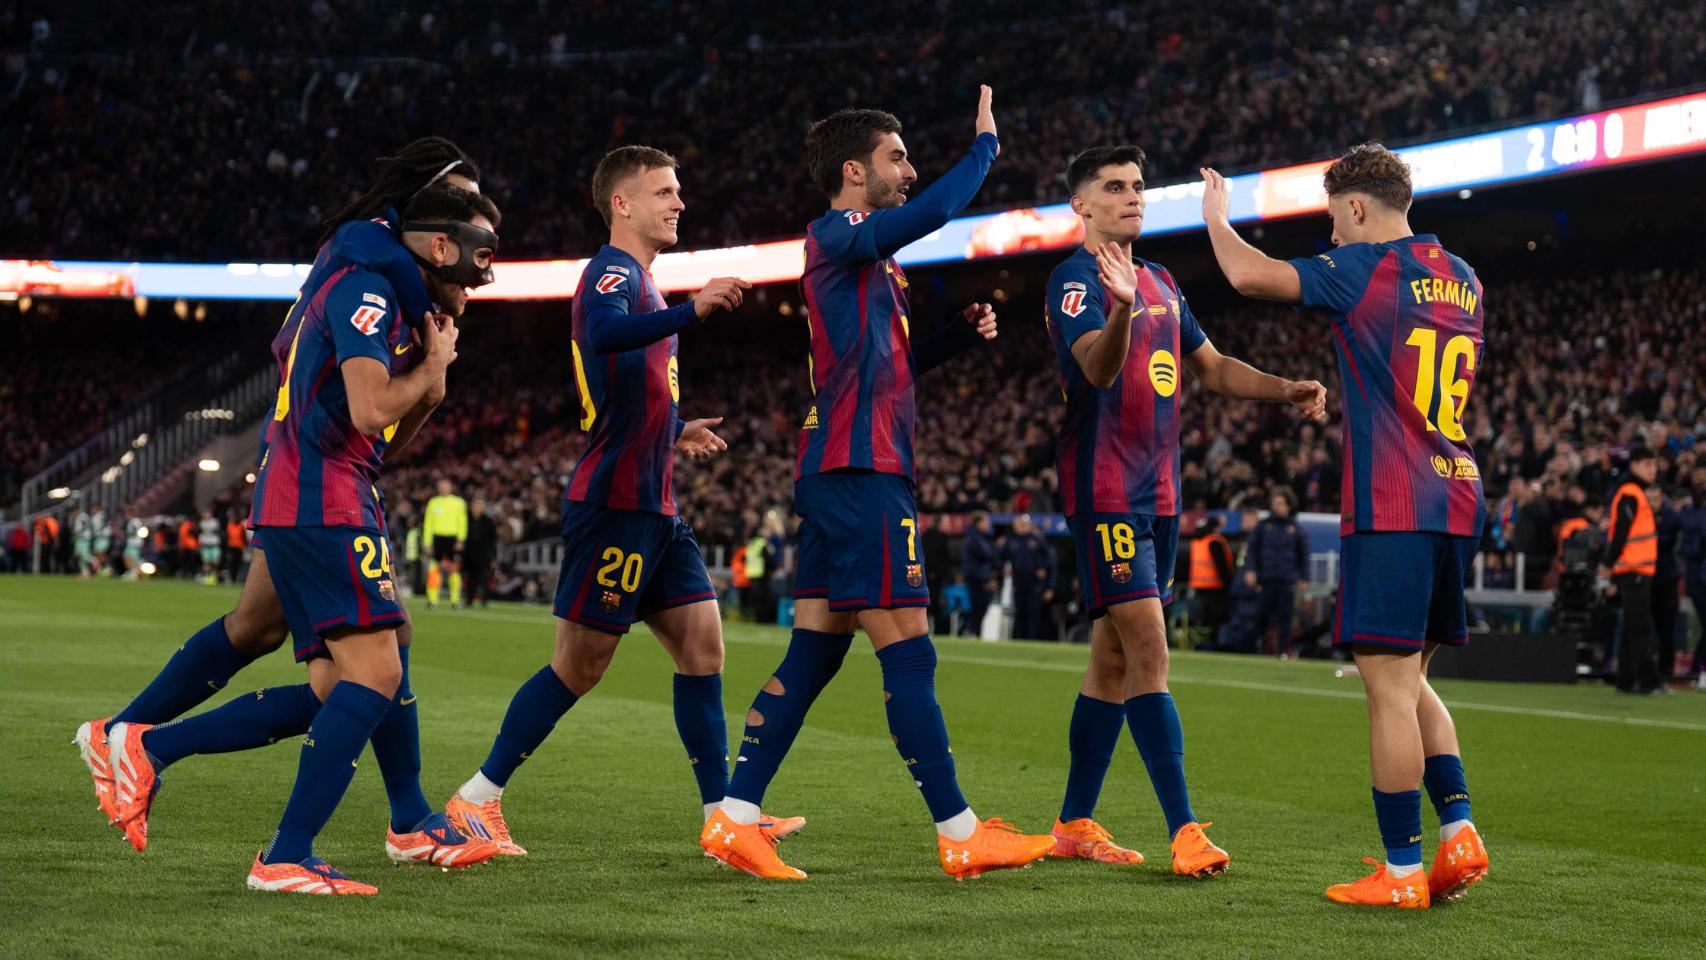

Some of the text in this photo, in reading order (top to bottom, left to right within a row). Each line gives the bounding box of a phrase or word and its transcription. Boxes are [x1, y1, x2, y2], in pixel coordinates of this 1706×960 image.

[1526, 127, 1545, 172] 2
[1410, 278, 1477, 316] FERMÍN
[1405, 327, 1475, 442] 16
[354, 535, 391, 579] 24
[901, 518, 916, 561] 7
[1095, 523, 1136, 562] 18
[597, 546, 643, 593] 20
